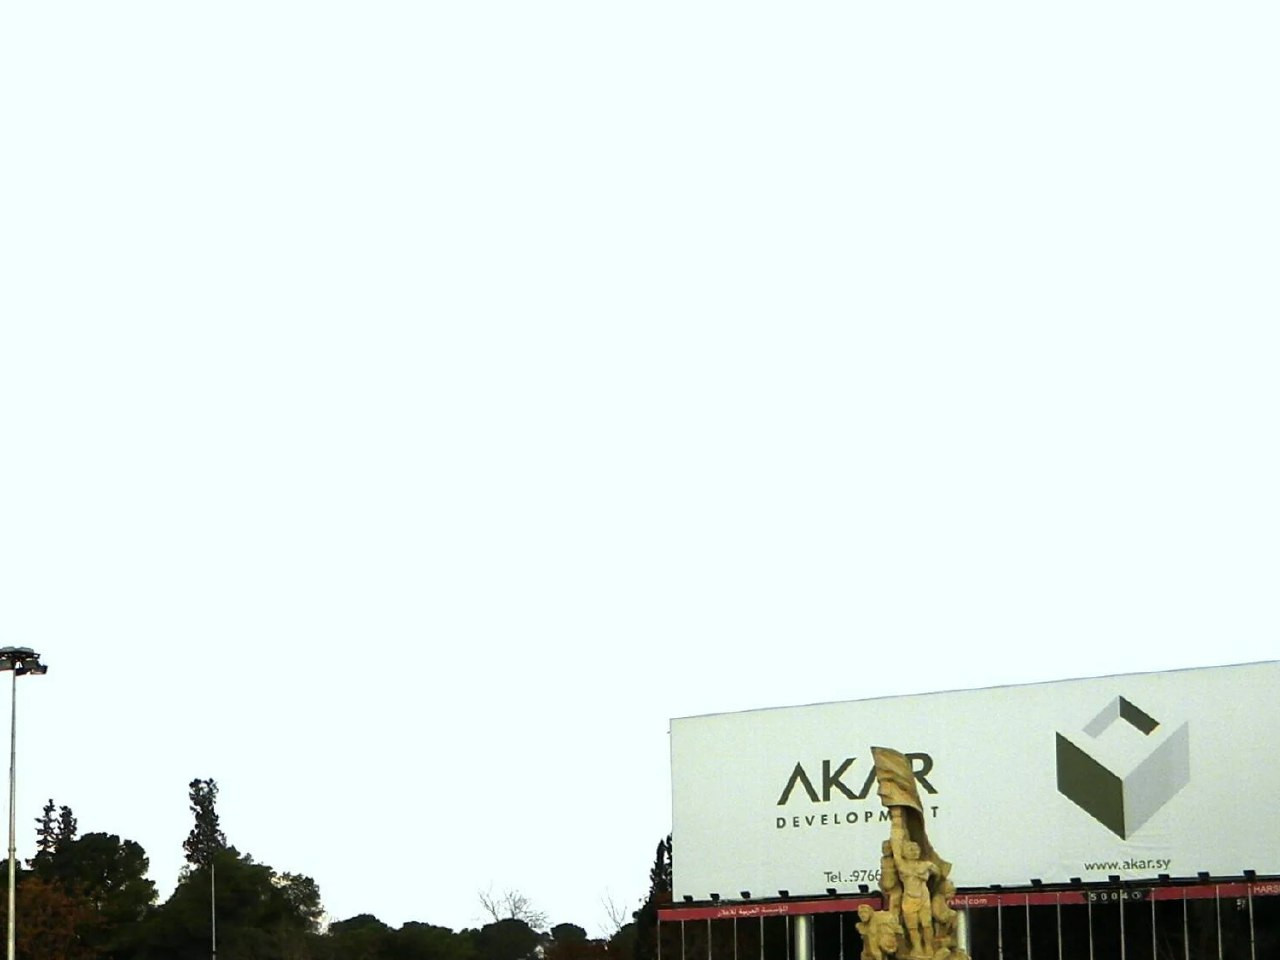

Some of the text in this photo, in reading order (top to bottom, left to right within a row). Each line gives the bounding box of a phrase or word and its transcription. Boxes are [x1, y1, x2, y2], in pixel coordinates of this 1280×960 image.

[777, 806, 940, 829] DEVELOPMT
[1084, 858, 1172, 872] www.akar.sy
[1253, 884, 1280, 894] HARS
